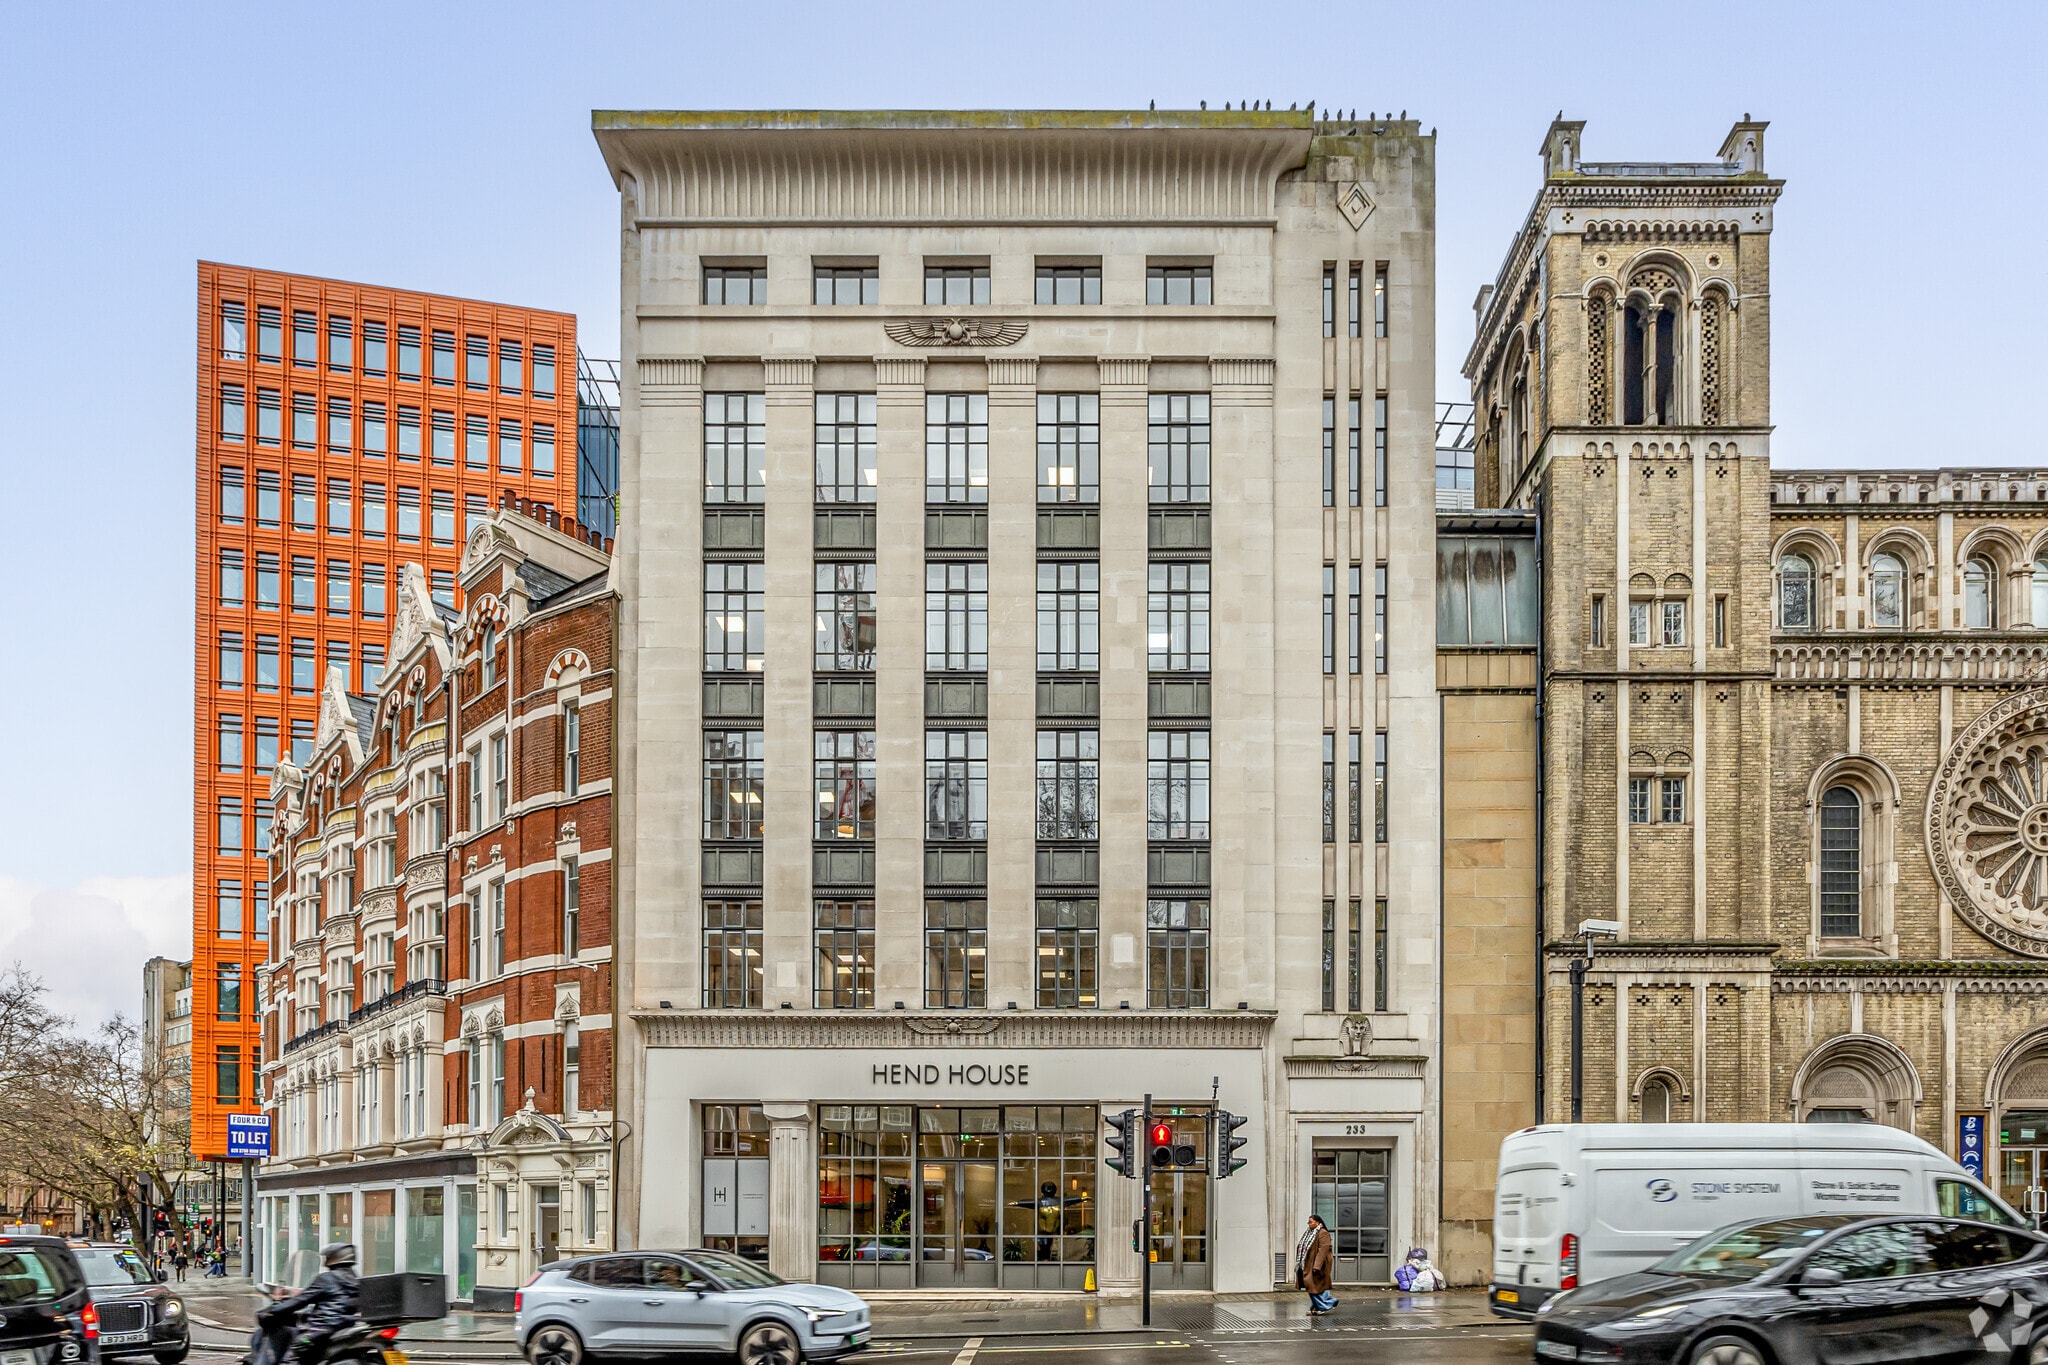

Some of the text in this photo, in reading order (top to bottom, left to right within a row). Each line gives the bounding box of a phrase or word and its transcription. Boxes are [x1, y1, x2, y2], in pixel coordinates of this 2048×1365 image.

[873, 1064, 1029, 1085] HEND HOUSE
[232, 1116, 251, 1124] FOUR
[1346, 1124, 1366, 1135] 233
[230, 1131, 268, 1145] TO LET
[1691, 1182, 1730, 1193] STONE
